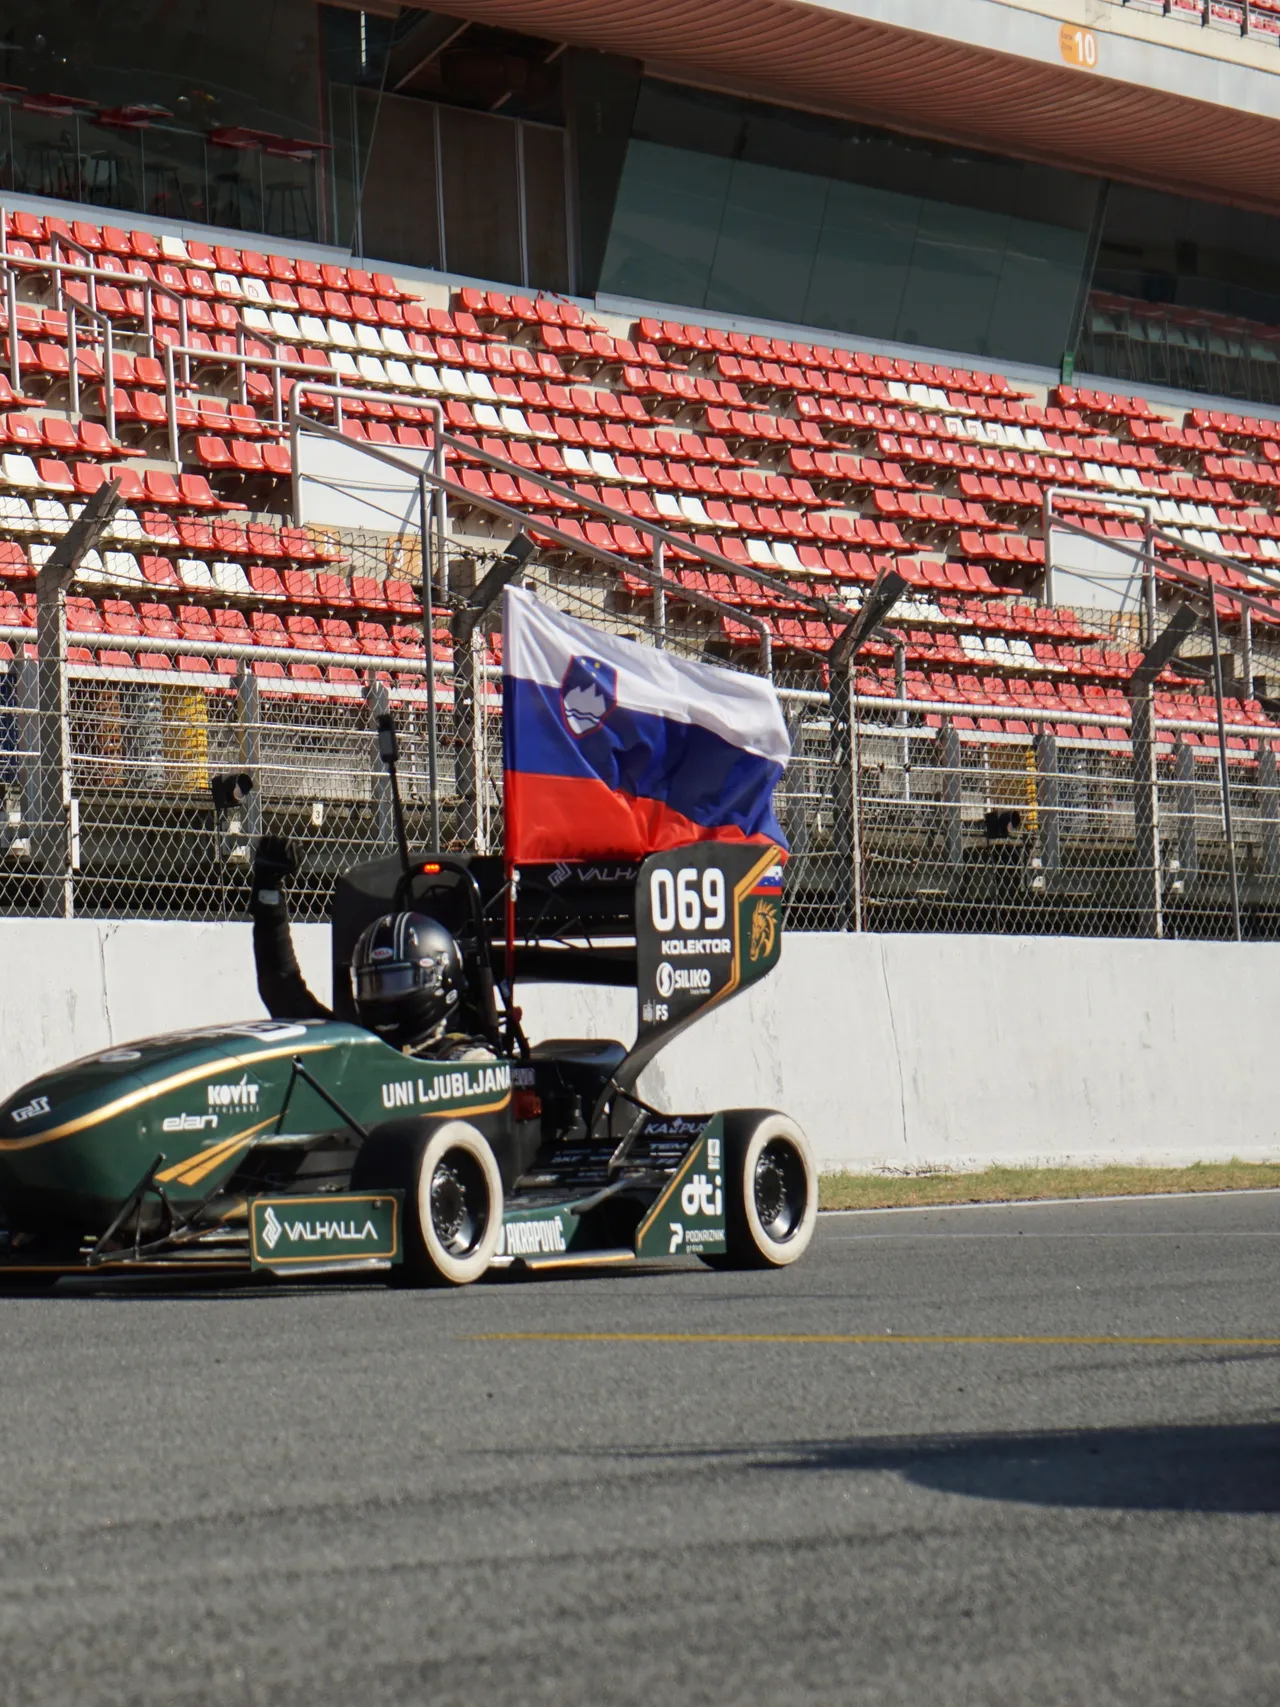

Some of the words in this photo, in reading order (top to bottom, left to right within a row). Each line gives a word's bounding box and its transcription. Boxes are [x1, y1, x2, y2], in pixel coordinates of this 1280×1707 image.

[1074, 31, 1095, 65] 10
[650, 868, 725, 931] 069
[661, 938, 731, 954] KOLEKTOR
[675, 969, 711, 988] SILIKO
[655, 1003, 669, 1021] FS
[382, 1080, 414, 1108] UNI
[417, 1065, 511, 1103] LJUBLJANA
[162, 1113, 218, 1132] elan
[681, 1174, 723, 1215] dti
[283, 1220, 379, 1242] VALHALLA
